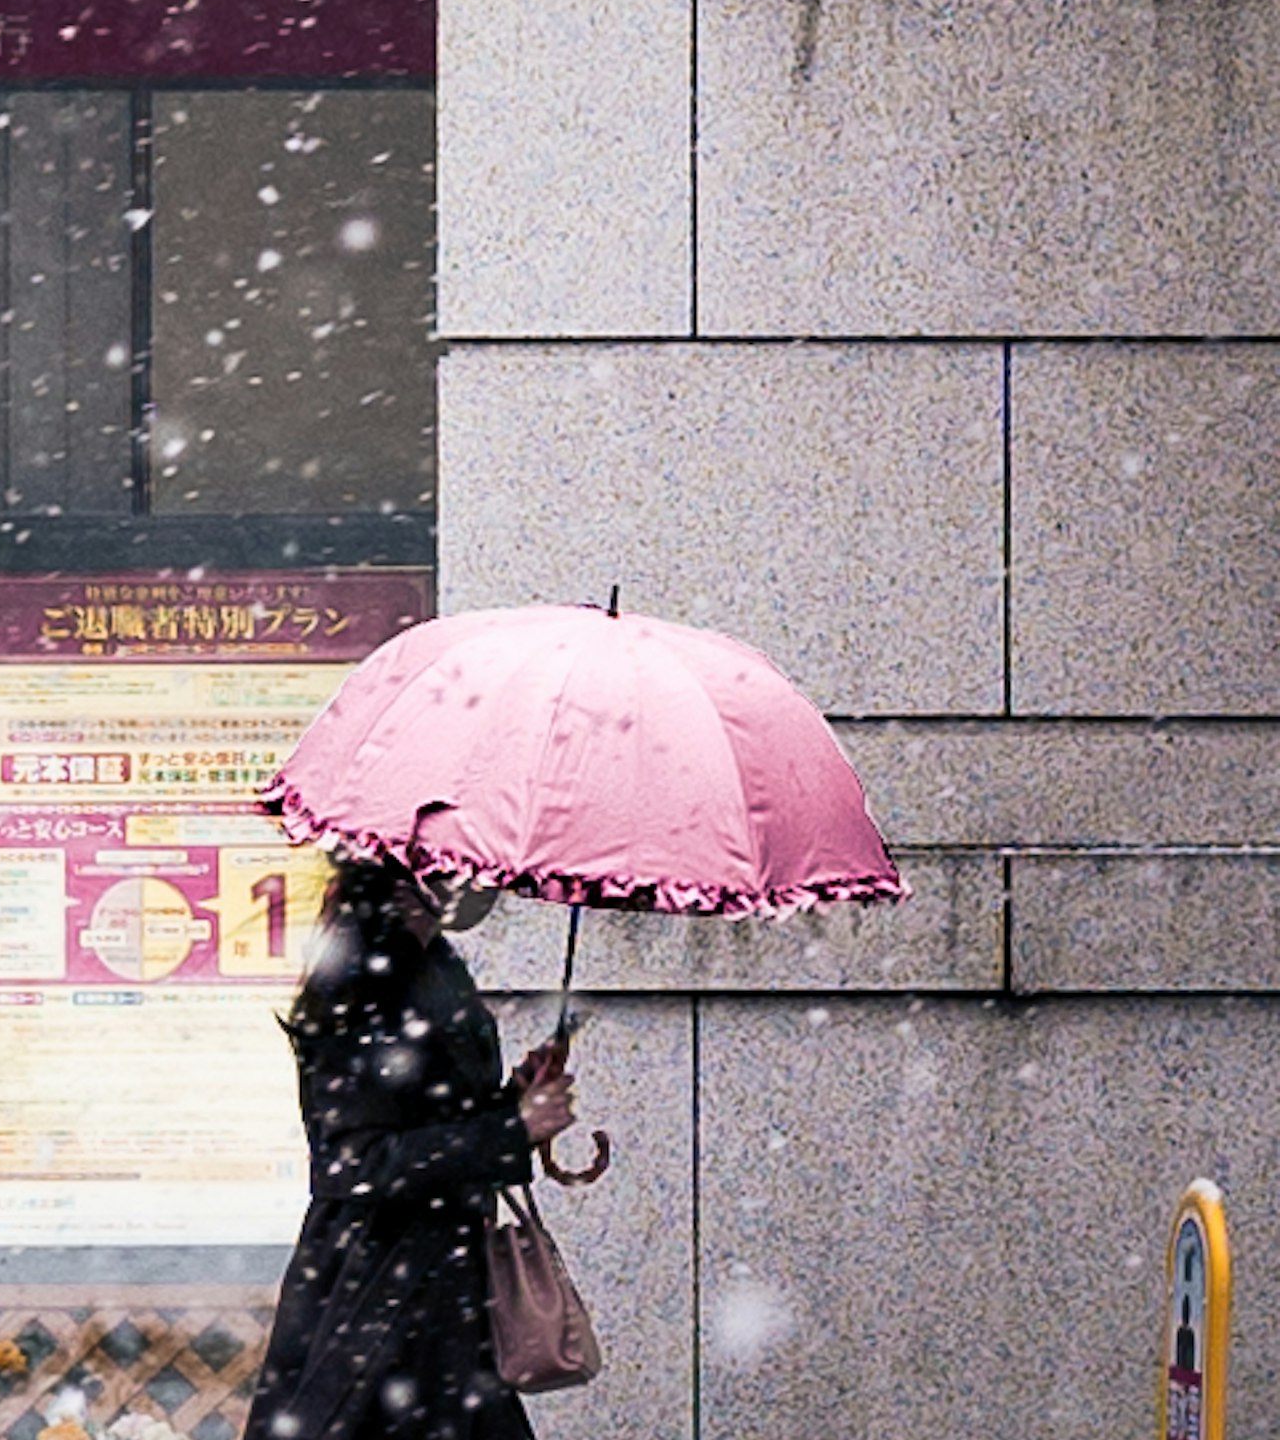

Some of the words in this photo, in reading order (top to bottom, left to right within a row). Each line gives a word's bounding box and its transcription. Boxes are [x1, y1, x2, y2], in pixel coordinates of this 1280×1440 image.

[42, 605, 349, 639] ご退職者特別プラン
[12, 755, 124, 783] 元本保証
